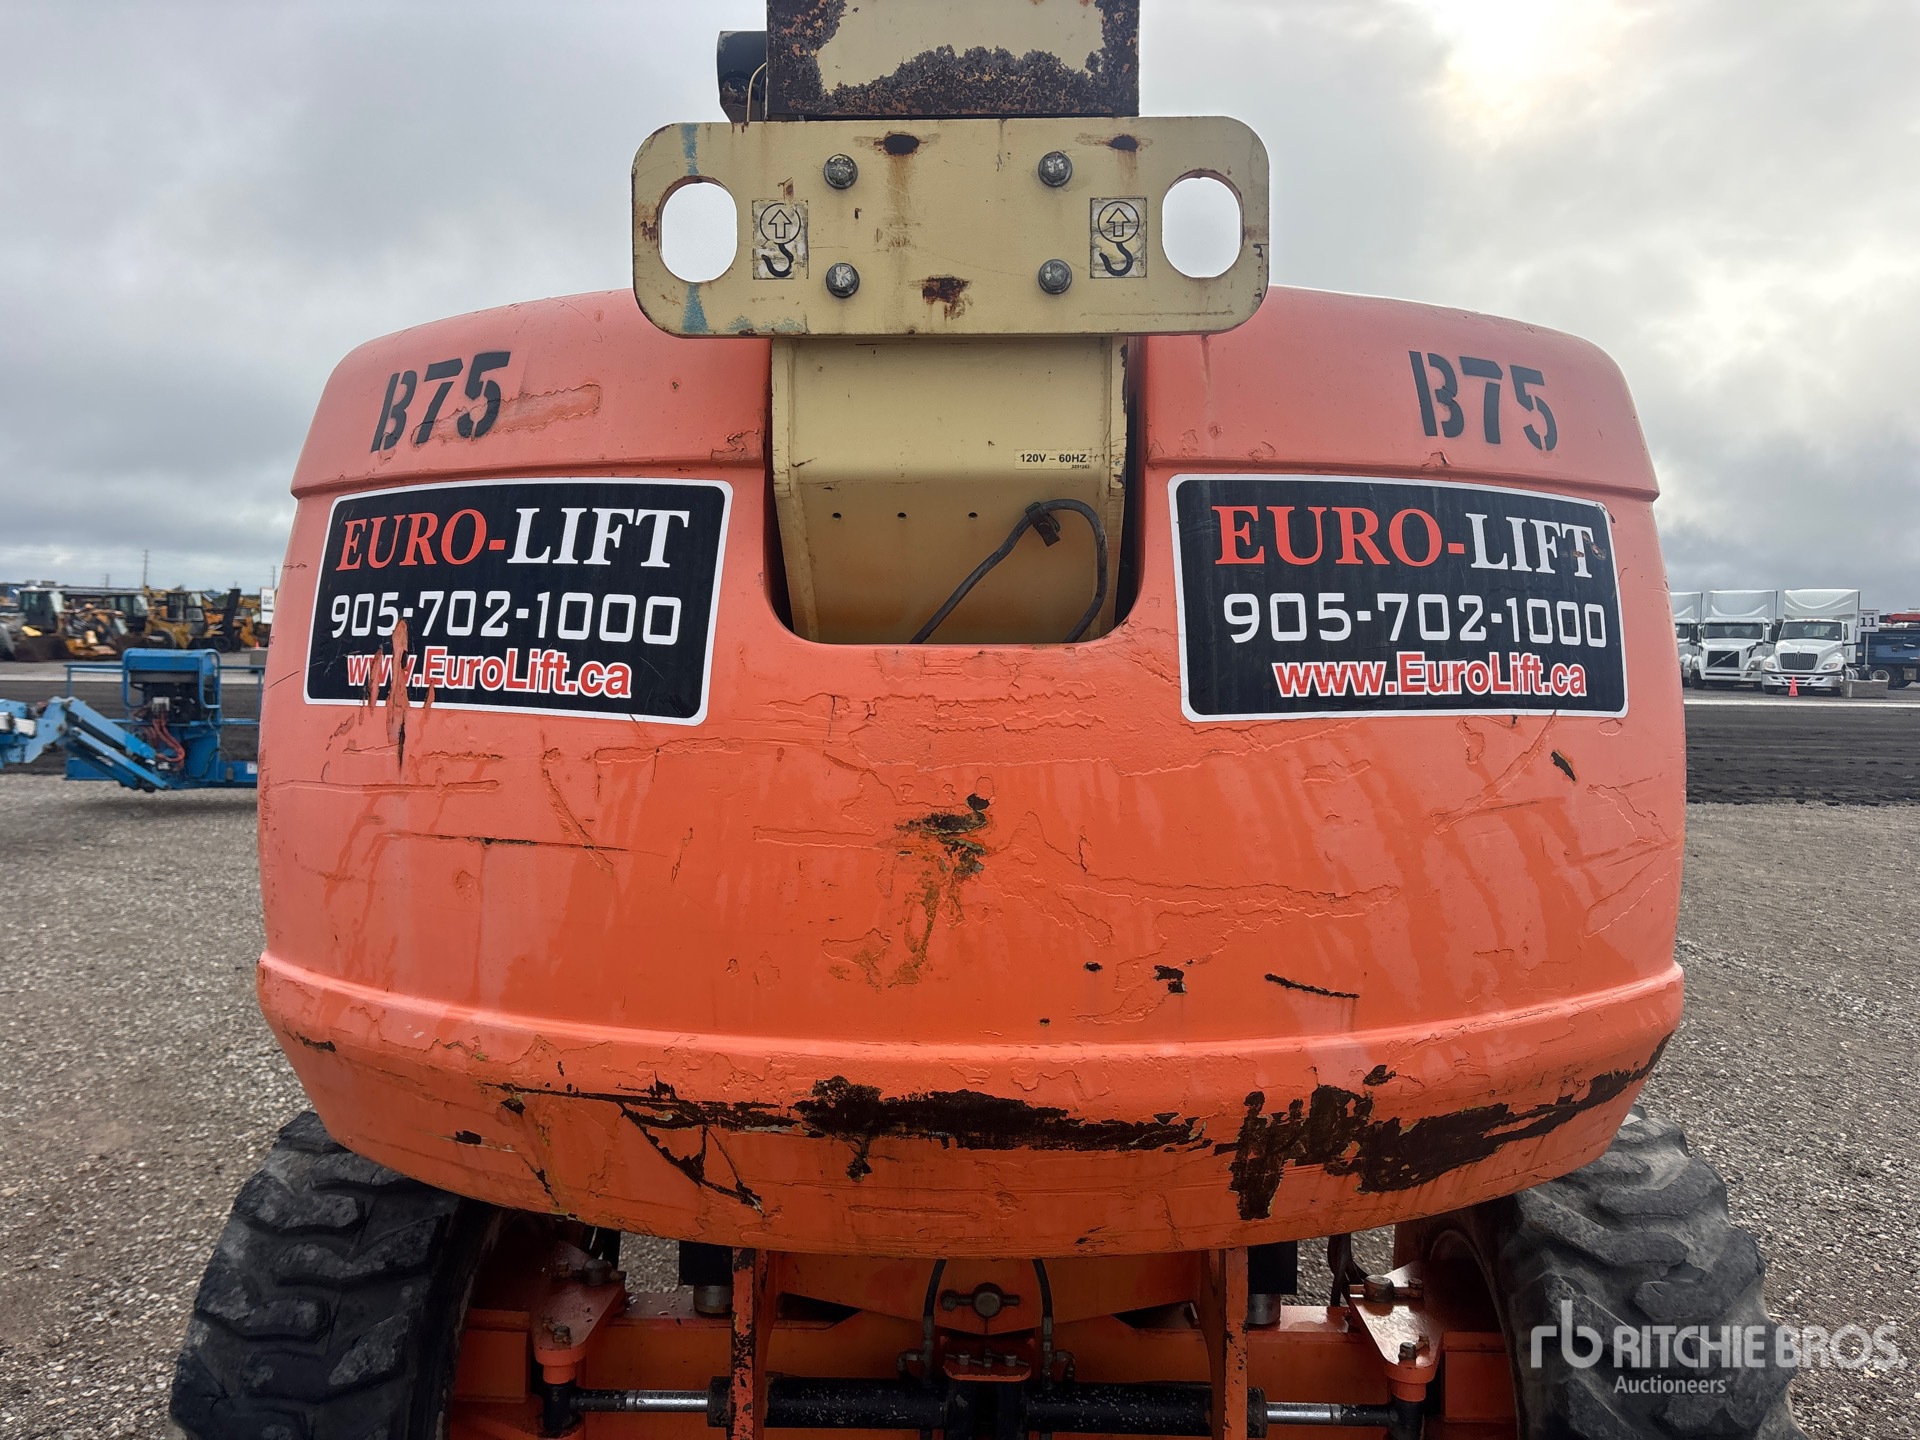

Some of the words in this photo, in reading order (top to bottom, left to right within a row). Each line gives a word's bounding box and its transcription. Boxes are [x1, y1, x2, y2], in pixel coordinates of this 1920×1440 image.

[370, 351, 511, 453] B75
[1409, 350, 1558, 452] B75
[1020, 454, 1046, 463] 120V
[1059, 454, 1086, 463] 60HZ
[335, 507, 690, 572] EURO-LIFT
[1211, 505, 1595, 579] EURO-LIFT
[330, 590, 682, 646] 905-702-1000
[1223, 592, 1607, 648] 905-702-1000
[1860, 617, 1877, 627] 11
[1272, 651, 1587, 698] www.EuroLift.ca
